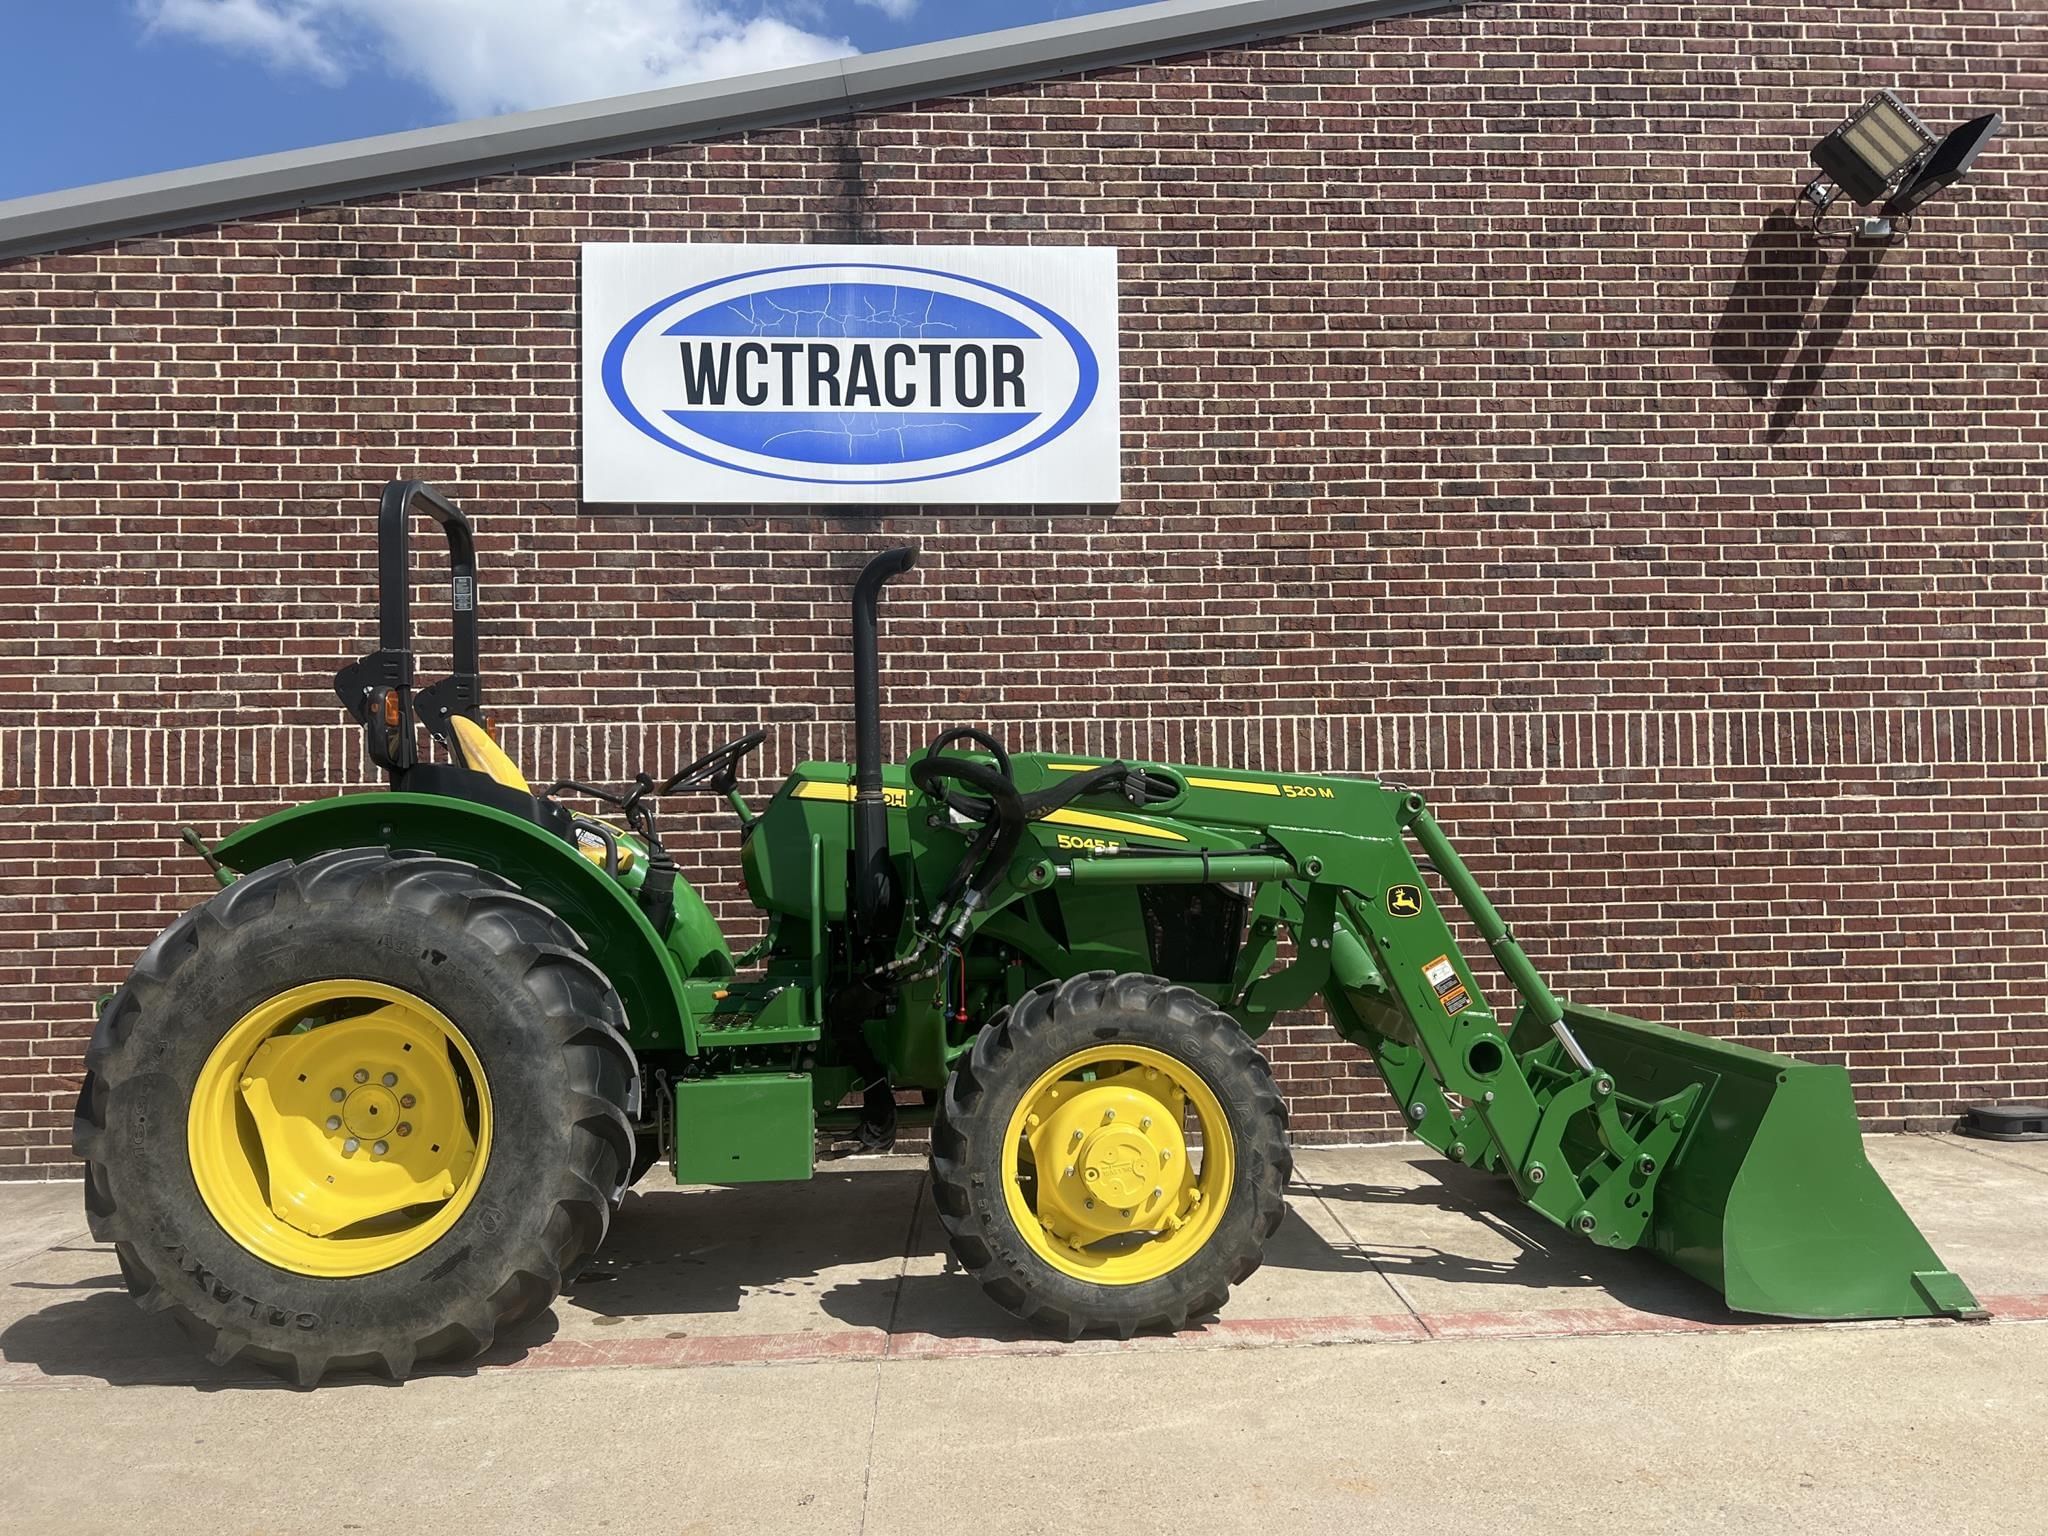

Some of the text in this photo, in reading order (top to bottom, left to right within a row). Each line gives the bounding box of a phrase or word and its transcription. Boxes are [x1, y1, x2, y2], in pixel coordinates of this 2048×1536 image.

[680, 341, 1026, 408] WCTRACTOR
[1282, 784, 1317, 798] 520
[163, 1244, 321, 1331] GALAXY
